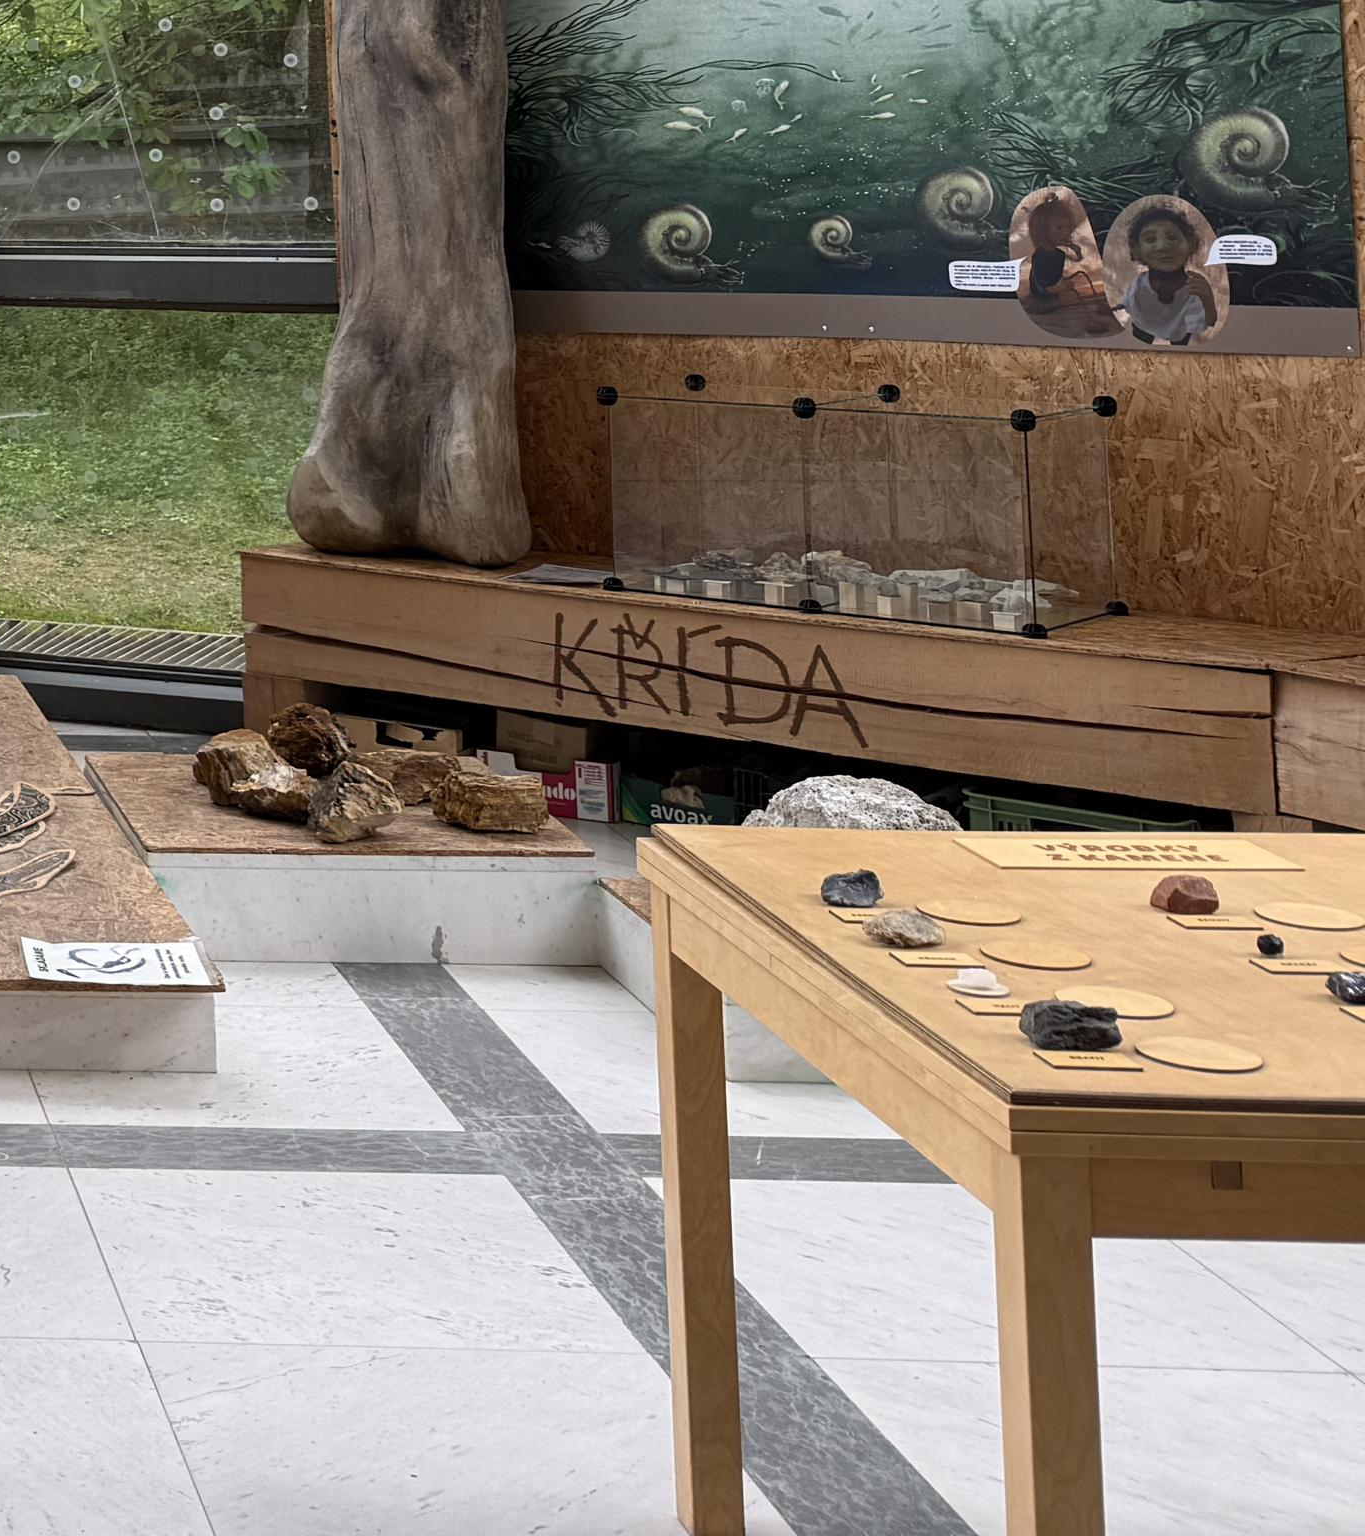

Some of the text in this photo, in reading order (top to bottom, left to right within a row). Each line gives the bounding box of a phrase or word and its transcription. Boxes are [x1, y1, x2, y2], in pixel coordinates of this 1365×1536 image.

[554, 612, 868, 748] KŘÍDA
[1033, 842, 1198, 853] VÝROBKY
[1046, 853, 1230, 862] Z KAMENE
